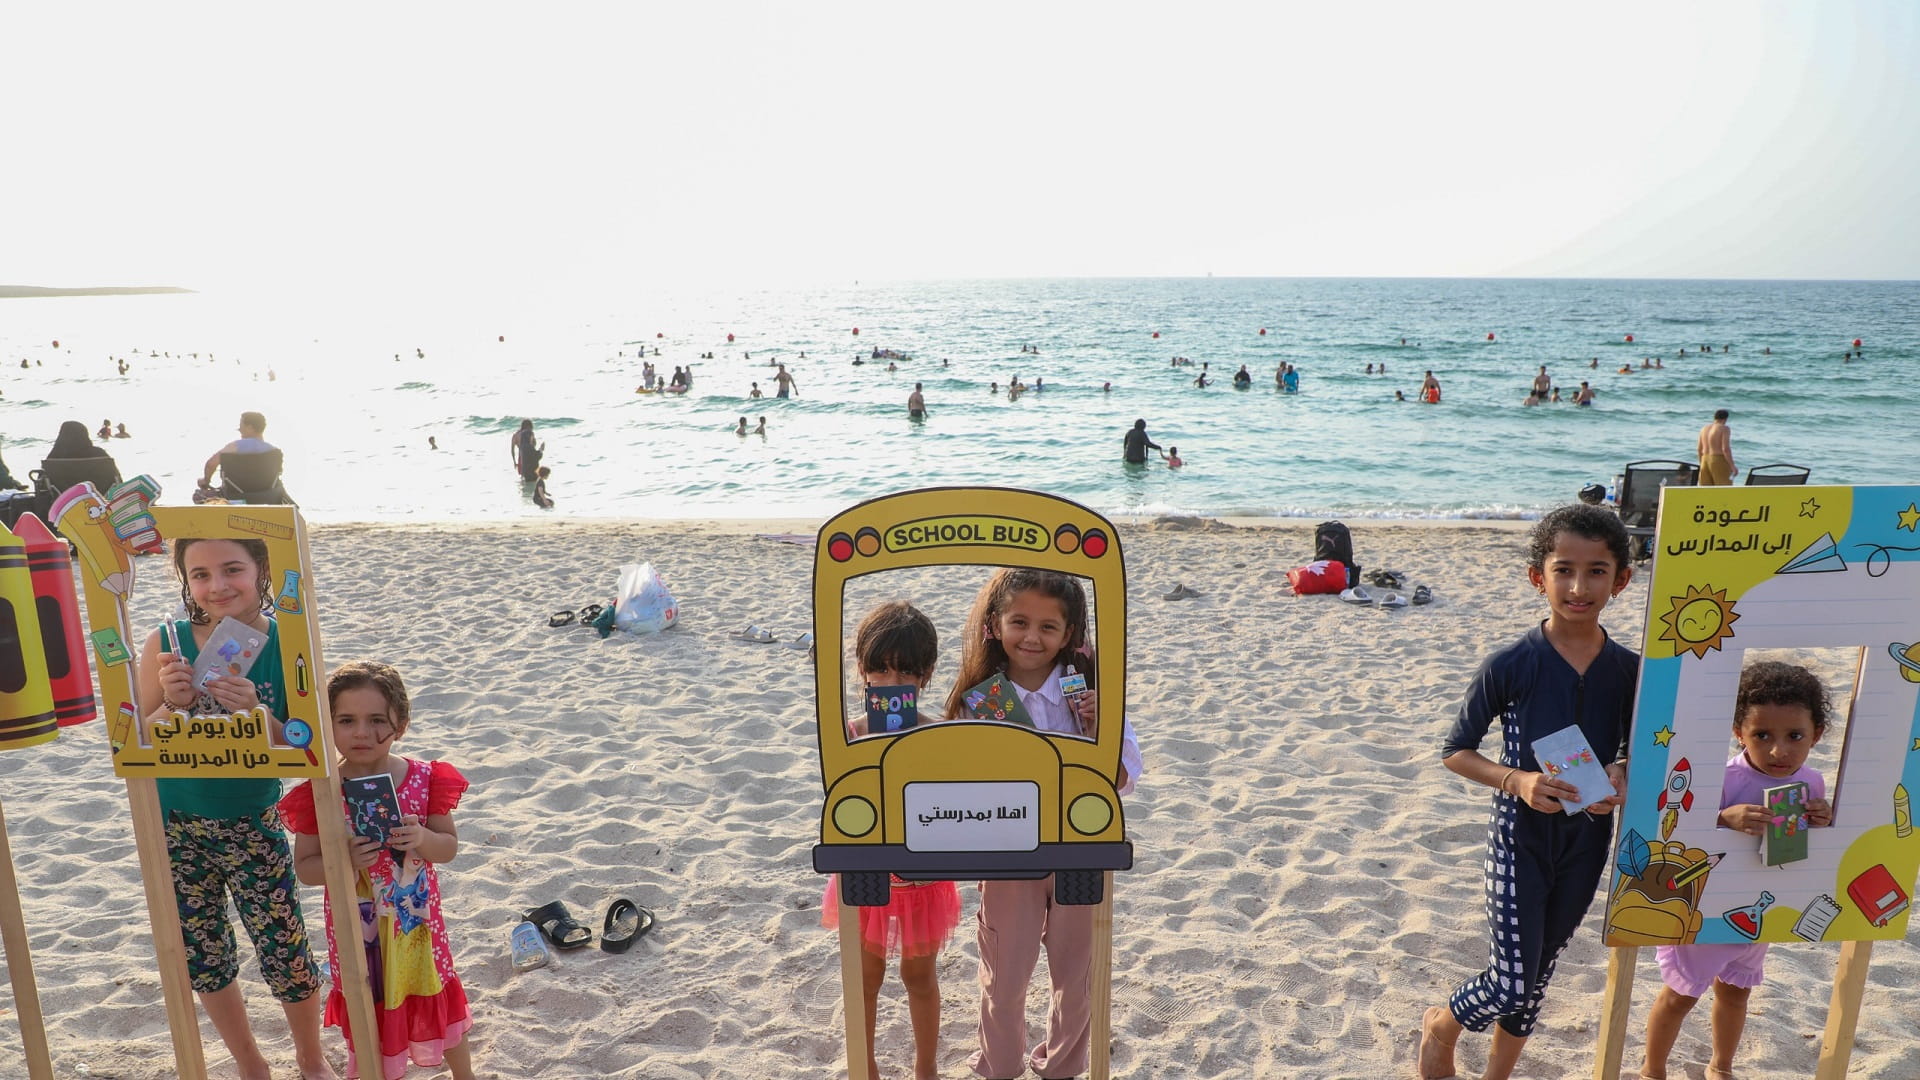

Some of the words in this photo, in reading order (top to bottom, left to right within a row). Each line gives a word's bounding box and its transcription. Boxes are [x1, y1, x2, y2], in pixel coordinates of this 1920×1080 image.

[1693, 505, 1770, 527] العودة
[893, 524, 986, 546] SCHOOL
[992, 525, 1038, 545] BUS
[1666, 534, 1760, 556] المدارس
[1762, 533, 1792, 555] إلى
[217, 636, 241, 662] R
[154, 718, 181, 744] لي
[188, 720, 225, 740] يوم
[230, 713, 263, 739] أول
[159, 748, 238, 769] المدرسة
[242, 749, 270, 769] من
[918, 806, 992, 827] بمدرستي
[996, 806, 1027, 819] اهلا
